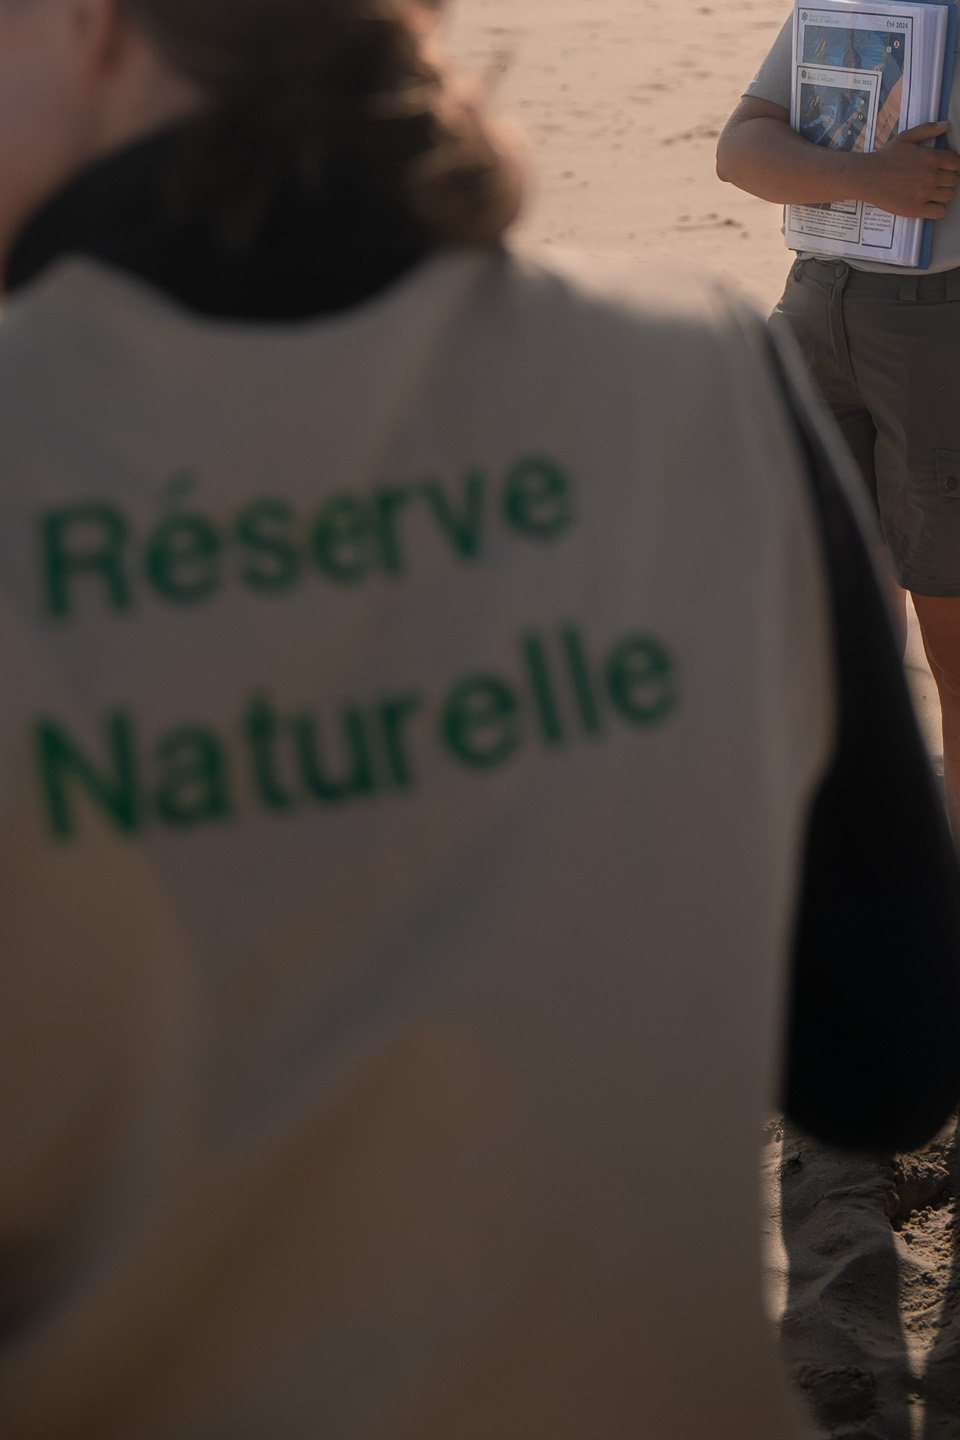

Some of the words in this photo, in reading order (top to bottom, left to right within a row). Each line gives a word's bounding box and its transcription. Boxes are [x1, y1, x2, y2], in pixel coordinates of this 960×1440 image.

[886, 20, 895, 28] Été
[896, 21, 908, 29] 2024
[38, 453, 574, 618] Réserve
[33, 621, 681, 842] Naturelle
